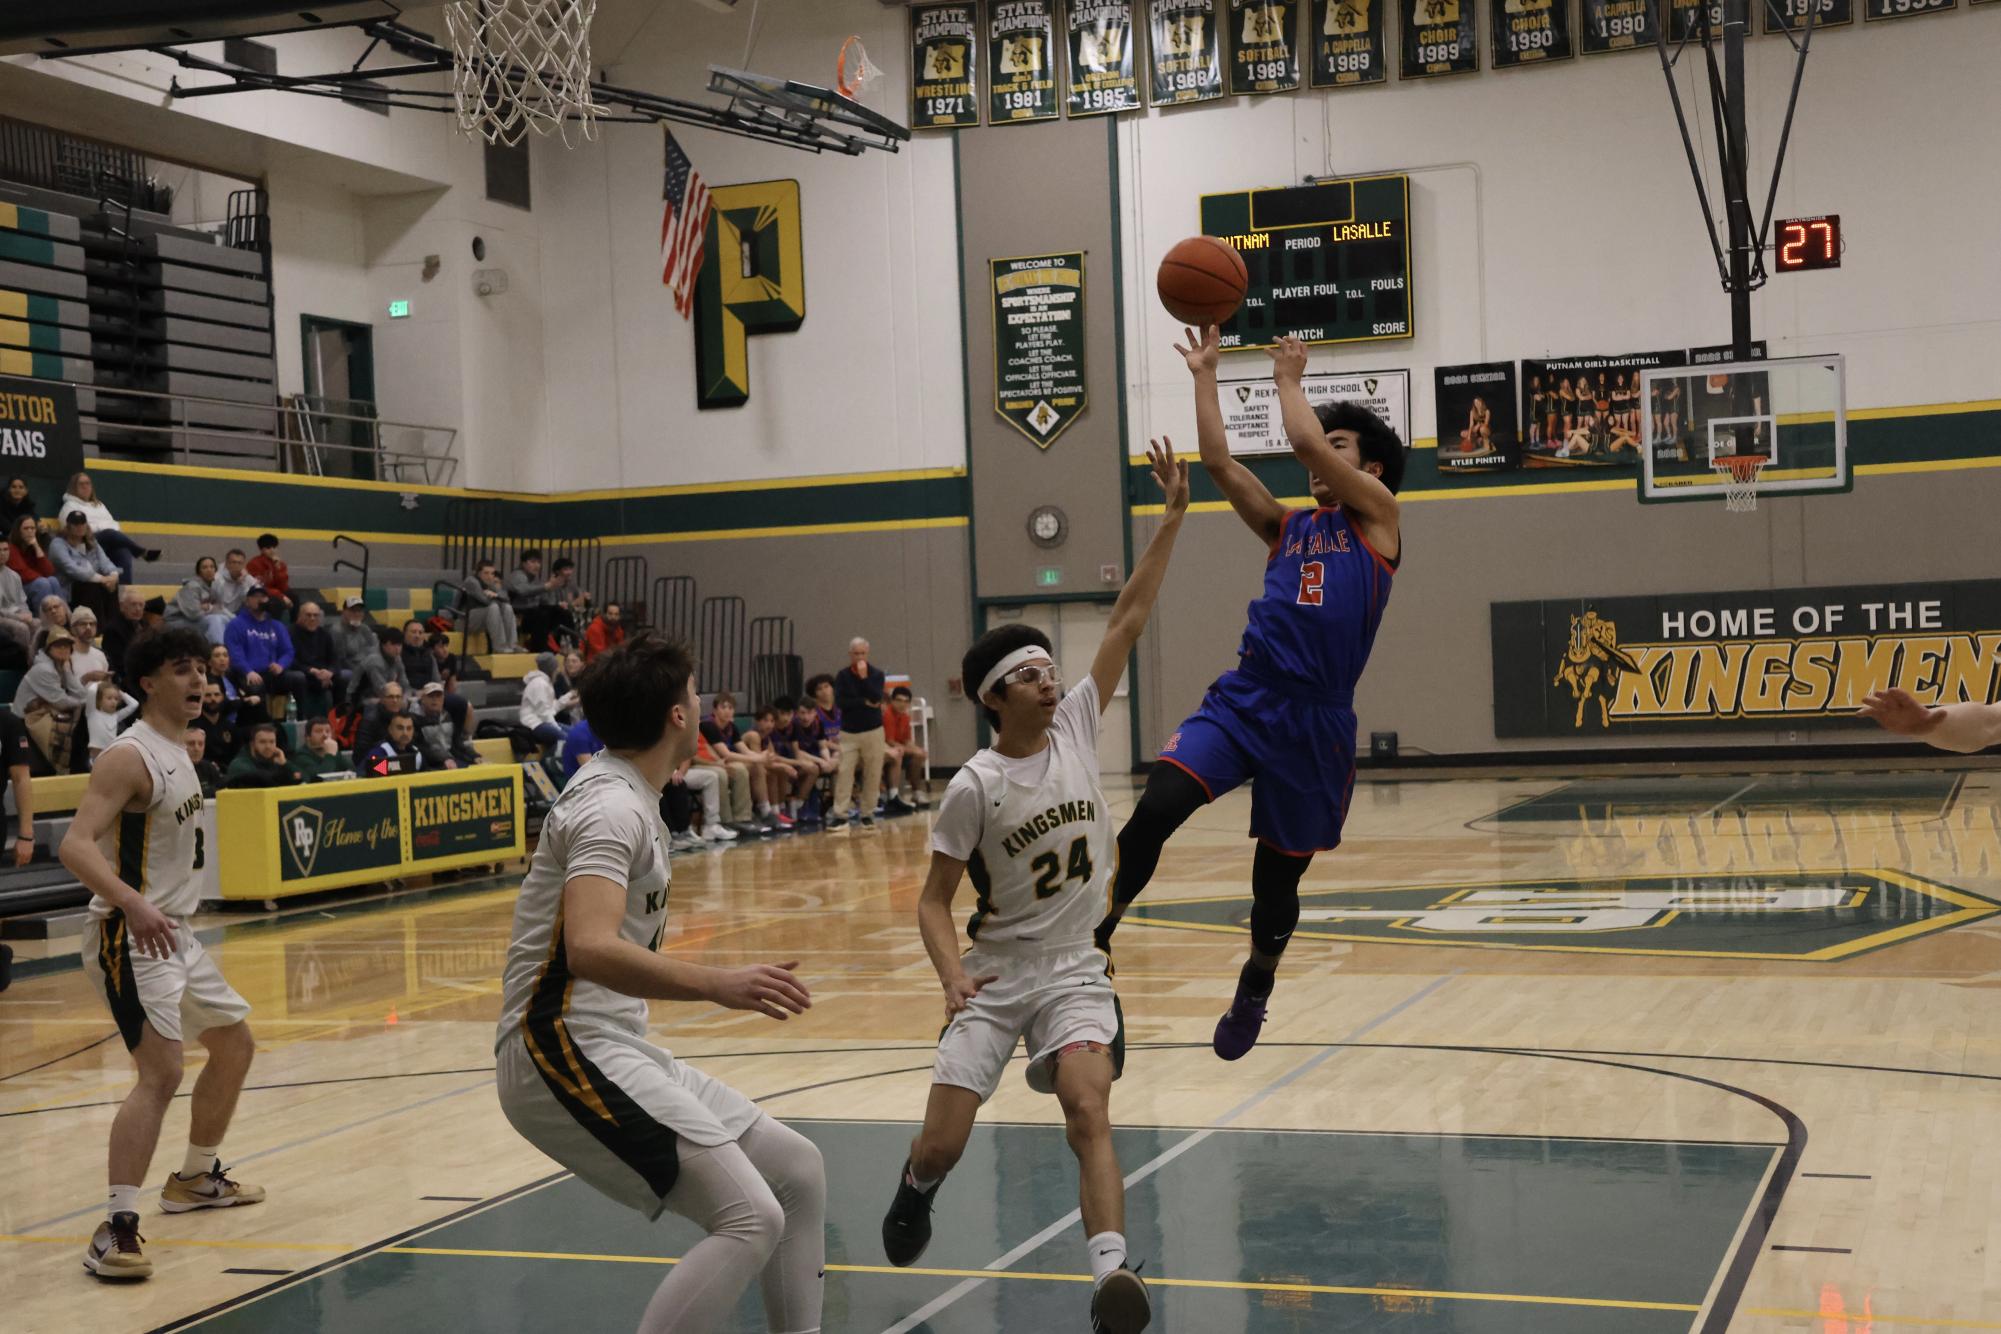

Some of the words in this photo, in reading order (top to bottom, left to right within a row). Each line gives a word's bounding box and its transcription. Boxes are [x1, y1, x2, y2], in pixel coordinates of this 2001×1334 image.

[921, 9, 967, 25] STATE
[998, 2, 1043, 19] STATE
[1070, 6, 1130, 30] CHAMPIONS
[992, 15, 1051, 38] CHAMPIONS
[1511, 14, 1551, 32] CHOIR
[1600, 14, 1645, 38] 1990
[916, 22, 975, 45] CHAMPIONS
[1420, 28, 1457, 45] CHOIR
[1510, 30, 1553, 52] 1990
[1238, 45, 1290, 63] SOFTBALL
[1332, 37, 1372, 54] CAPPELLA
[1418, 43, 1460, 64] 1989
[1247, 61, 1286, 81] 1989
[1328, 53, 1370, 73] 1989
[916, 82, 974, 98] WRESTLING
[1083, 88, 1125, 109] 1985
[927, 98, 964, 115] 1971
[1005, 90, 1042, 109] 1981
[1333, 221, 1392, 242] LASALLE
[1285, 237, 1321, 251] PERIOD
[1783, 223, 1832, 264] 27
[1010, 259, 1052, 271] WELCOME
[1054, 257, 1066, 267] TO
[1273, 286, 1310, 299] PLAYER
[1313, 284, 1339, 297] FOUL
[1371, 278, 1404, 291] FOULS
[1289, 328, 1324, 341] MATCH
[1373, 322, 1406, 335] SCORE
[1546, 362, 1582, 371] PUTNAM
[1584, 360, 1607, 369] GIRLS
[1609, 357, 1660, 367] BASKETBALL
[1255, 388, 1269, 398] REX
[1308, 385, 1327, 395] HIGH
[1330, 383, 1361, 394] SCHOOL
[1244, 404, 1269, 412] SAFETY
[1225, 421, 1269, 431] ACCEPTANCE
[1229, 414, 1269, 422] TOLERANCE
[0, 427, 46, 458] ANS
[1238, 430, 1269, 438] RESPECT
[1265, 439, 1273, 447] IS
[1276, 439, 1282, 447] A
[1475, 456, 1506, 465] PINETTE
[1296, 560, 1324, 607] 2
[1662, 607, 1776, 639] HOME
[1792, 604, 1845, 634] OF
[1861, 600, 1943, 631] THE
[1609, 633, 2001, 718] KINGSMEN
[413, 786, 512, 828] KINGSMEN
[323, 817, 364, 849] Home
[367, 823, 379, 850] of
[380, 817, 400, 840] the
[1002, 800, 1096, 858] KINGSMEN
[1030, 833, 1092, 901] 24
